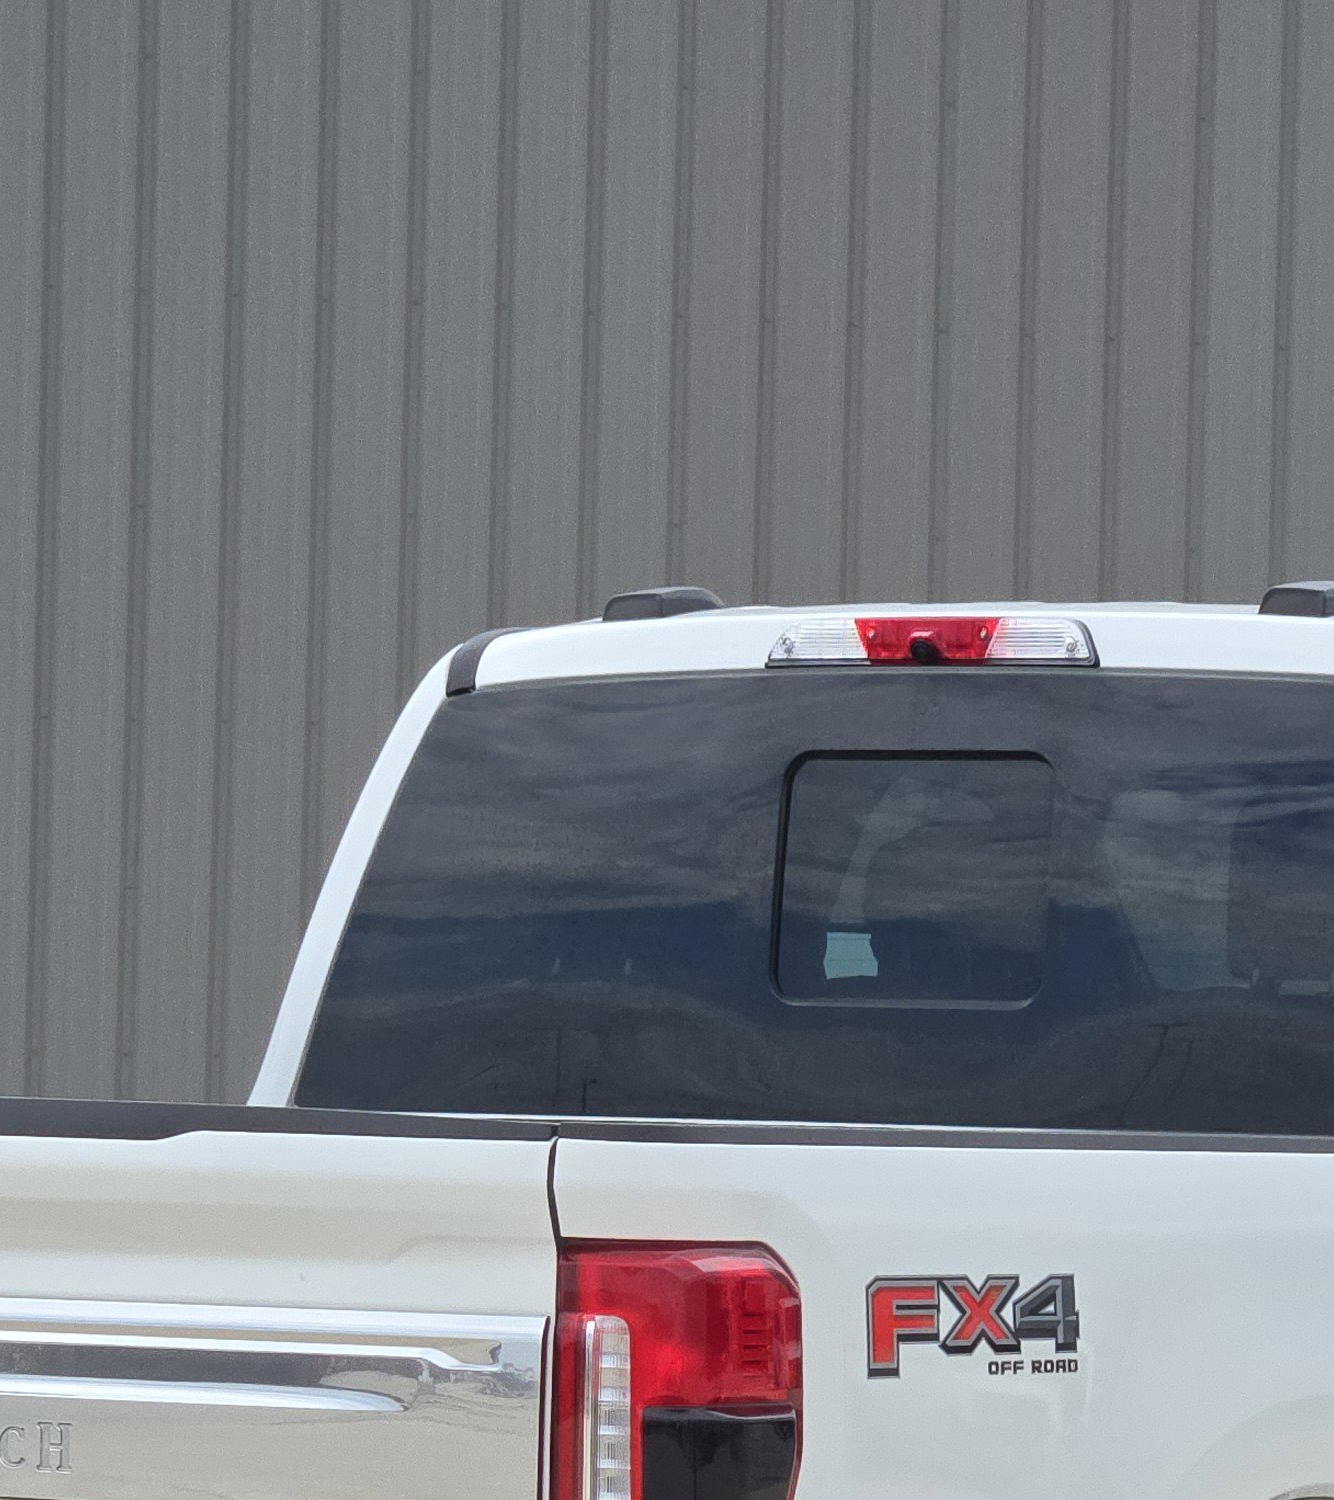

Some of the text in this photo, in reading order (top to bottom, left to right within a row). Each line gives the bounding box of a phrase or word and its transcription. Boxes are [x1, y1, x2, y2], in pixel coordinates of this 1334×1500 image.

[865, 1273, 1081, 1380] FX4
[988, 1358, 1079, 1376] OFF ROAD
